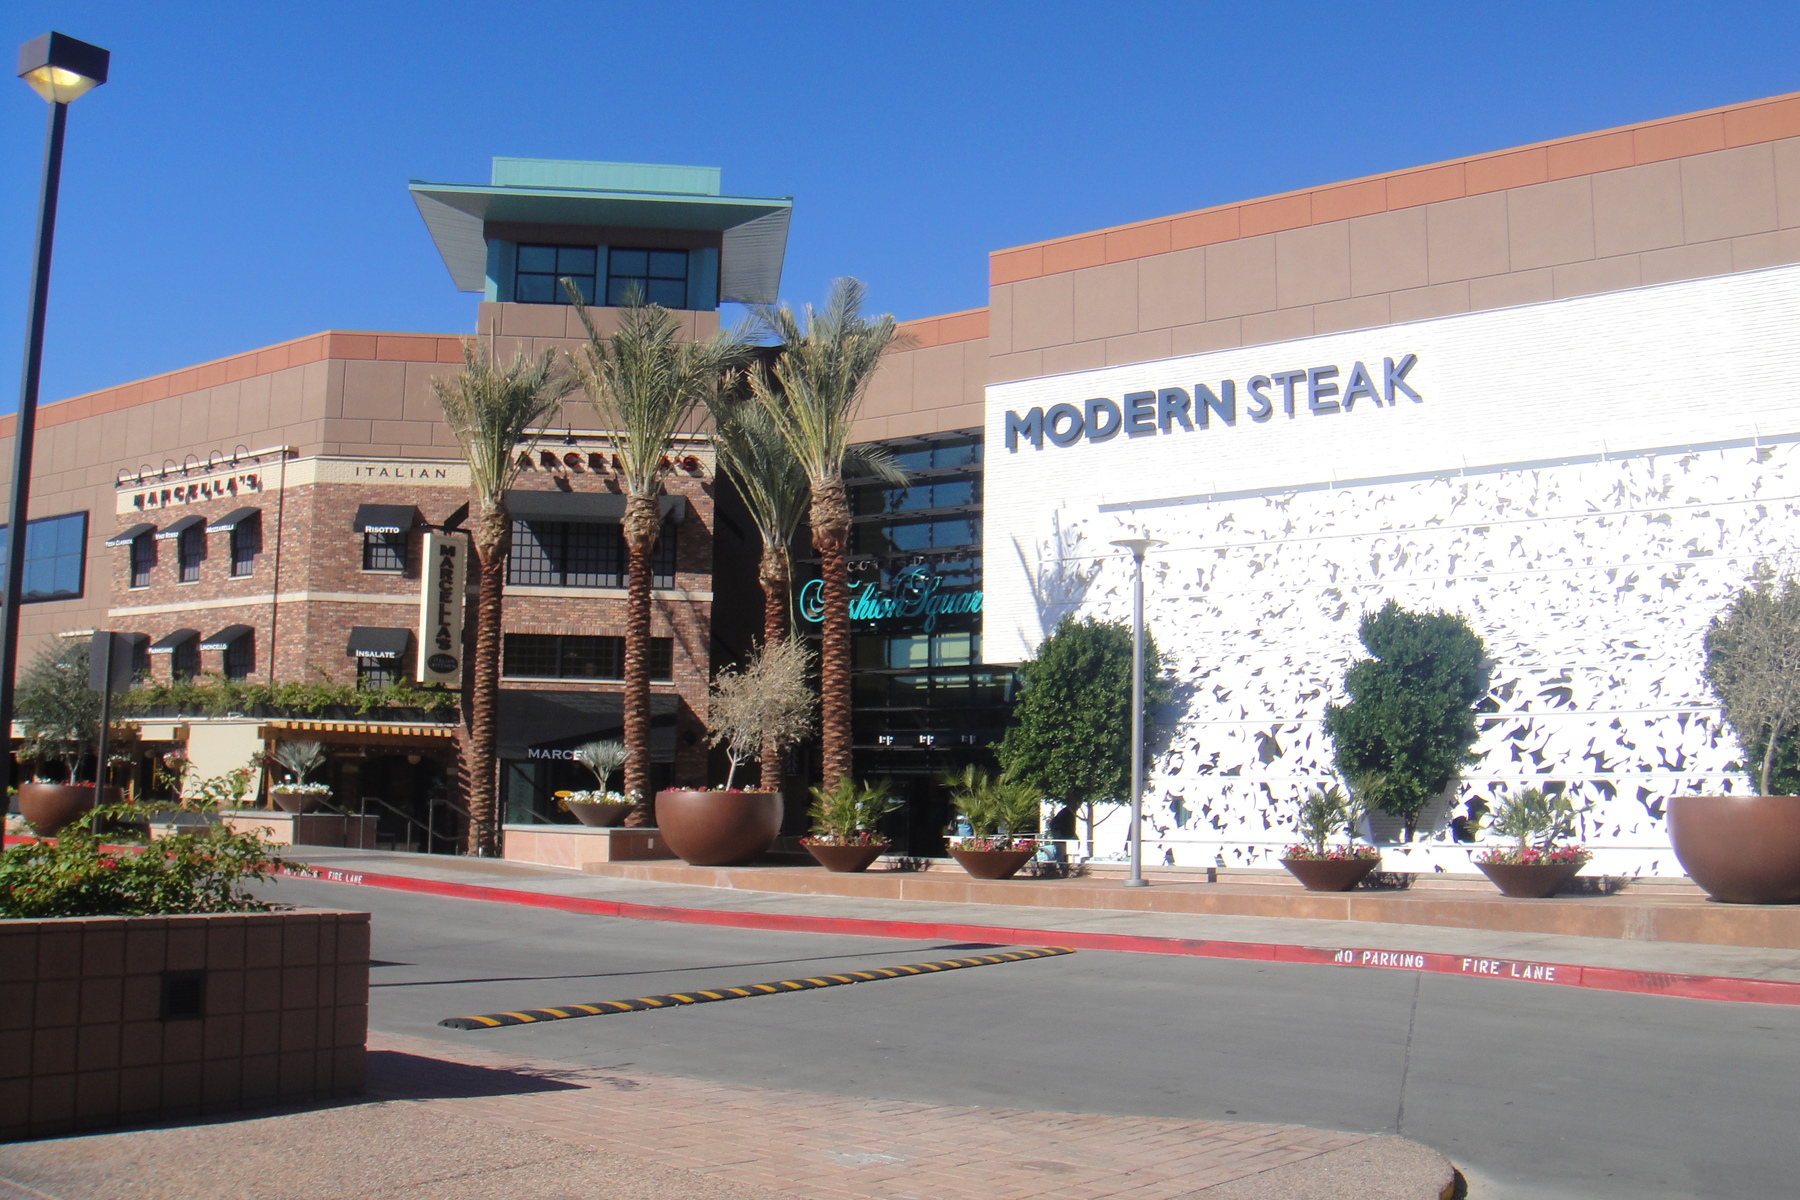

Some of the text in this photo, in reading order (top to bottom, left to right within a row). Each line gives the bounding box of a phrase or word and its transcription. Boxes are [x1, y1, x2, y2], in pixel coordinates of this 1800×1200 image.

[1005, 353, 1424, 454] MODERN STEAK
[355, 466, 447, 479] ITALIAN
[133, 473, 259, 508] MARCELLA'S
[364, 525, 400, 534] RISOTTO
[894, 567, 983, 633] Squar
[355, 649, 396, 659] INSALATE
[328, 871, 343, 882] FIRE
[345, 873, 363, 884] LANE
[1334, 949, 1555, 981] NO PARKING FIRE LANE
